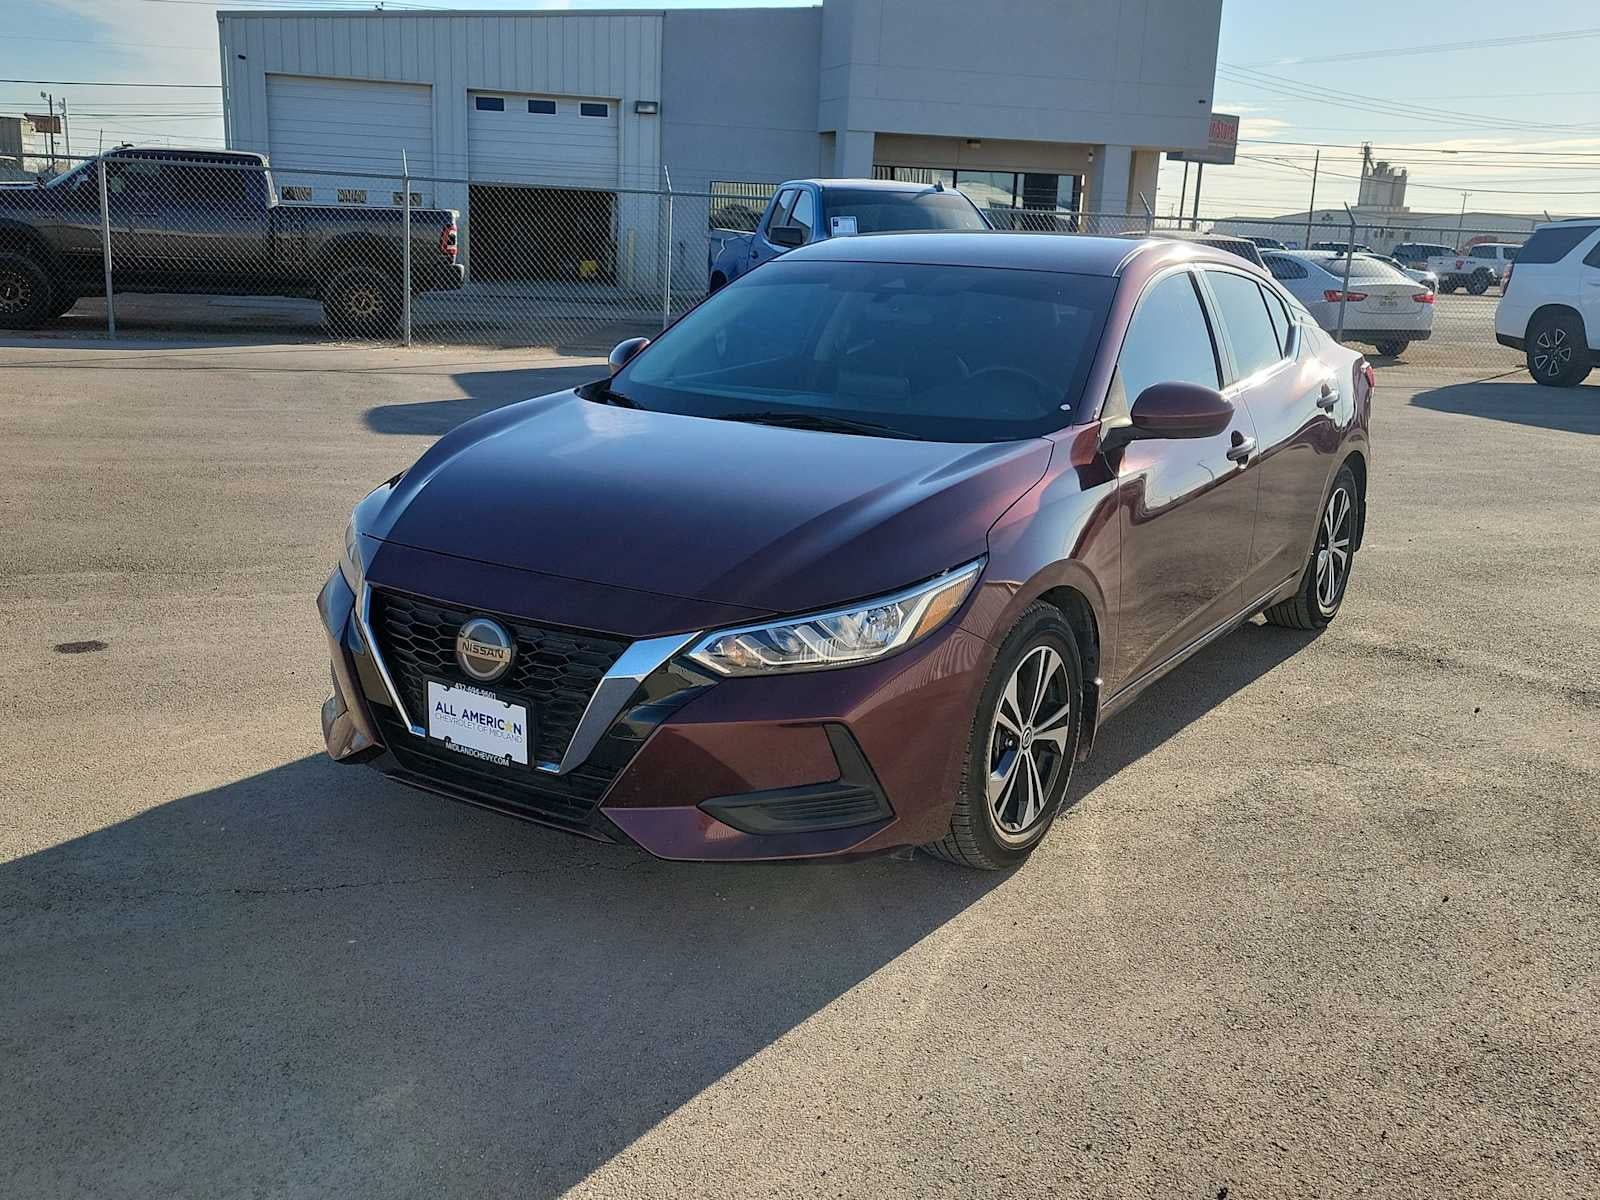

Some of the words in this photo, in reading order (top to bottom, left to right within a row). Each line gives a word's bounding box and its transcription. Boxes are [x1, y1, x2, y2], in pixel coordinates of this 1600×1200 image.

[462, 639, 504, 659] NISSAN
[435, 701, 457, 717] ALL
[435, 712, 476, 730] CHEVROLET
[477, 725, 488, 733] OF
[489, 729, 524, 744] MIDLAND
[445, 742, 510, 767] MIDLANDCHEVY.COM
